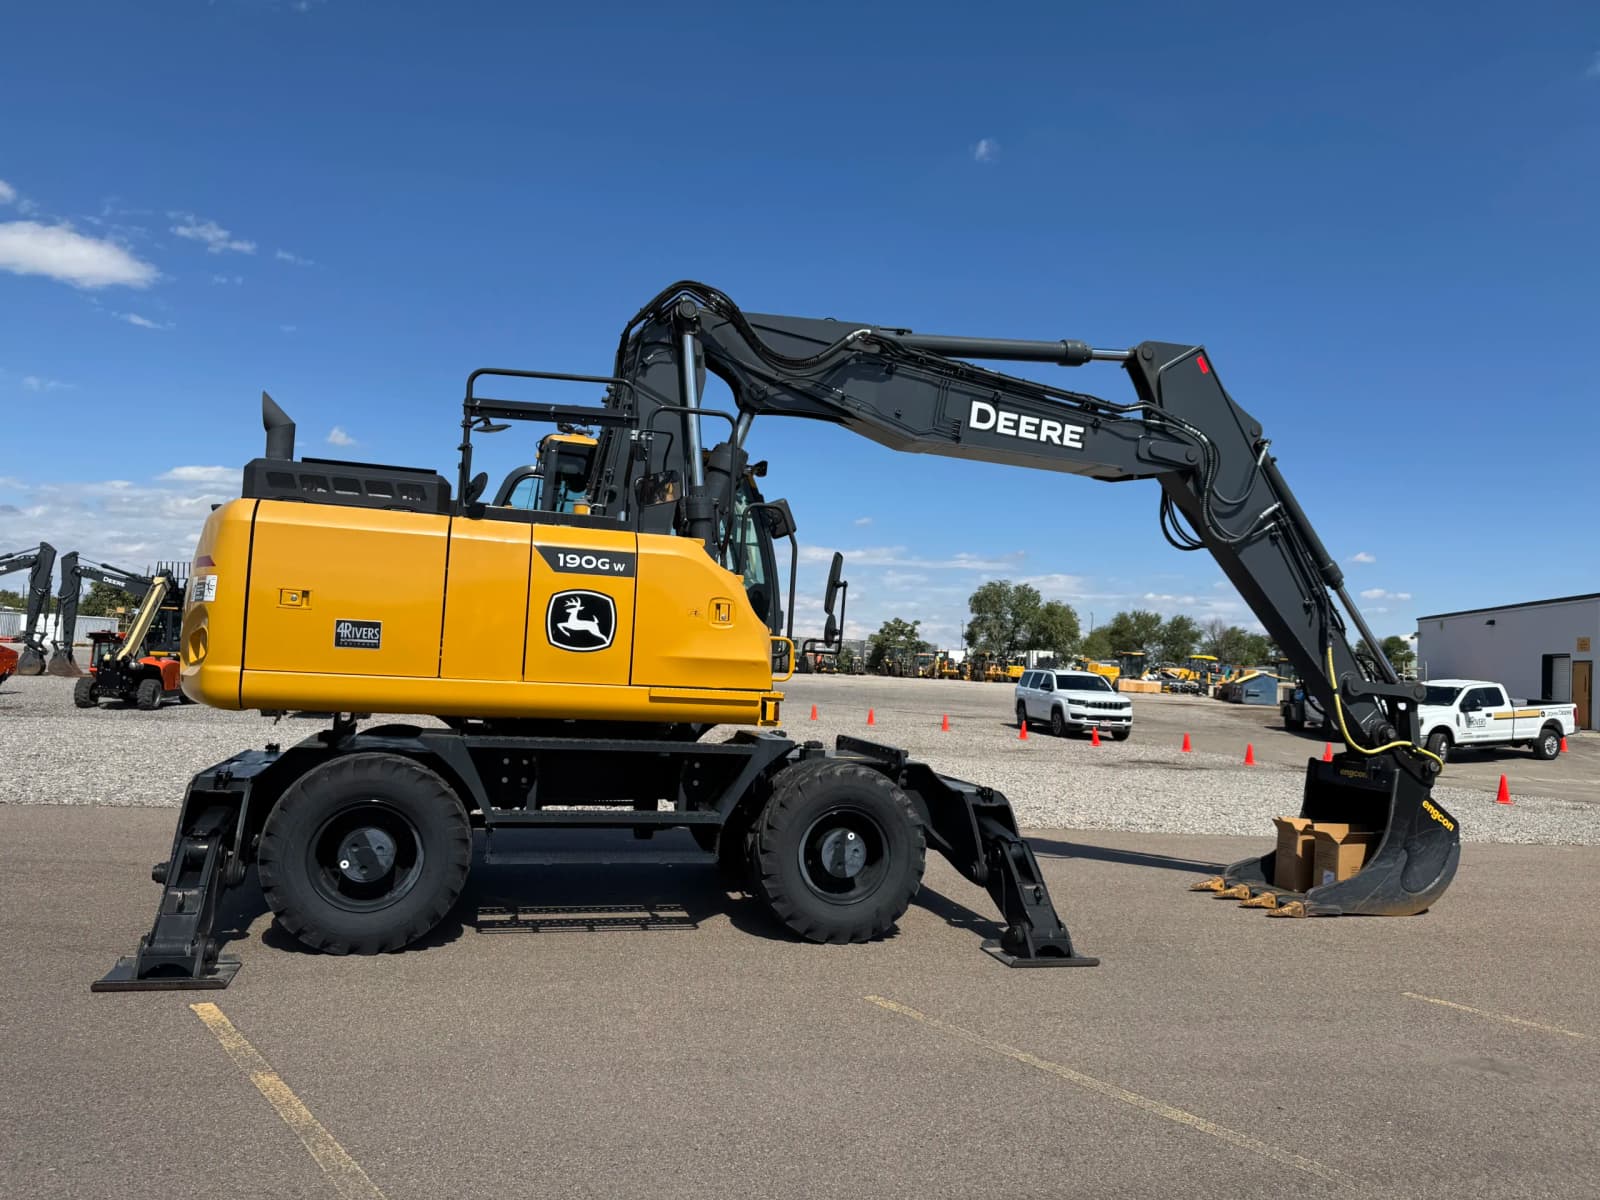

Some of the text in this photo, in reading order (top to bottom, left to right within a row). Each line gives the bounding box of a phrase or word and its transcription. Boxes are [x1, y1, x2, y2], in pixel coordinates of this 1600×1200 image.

[969, 400, 1085, 449] DEERE
[557, 553, 610, 570] 190G
[336, 622, 380, 640] 4RIVERS
[1422, 800, 1455, 832] engcon
